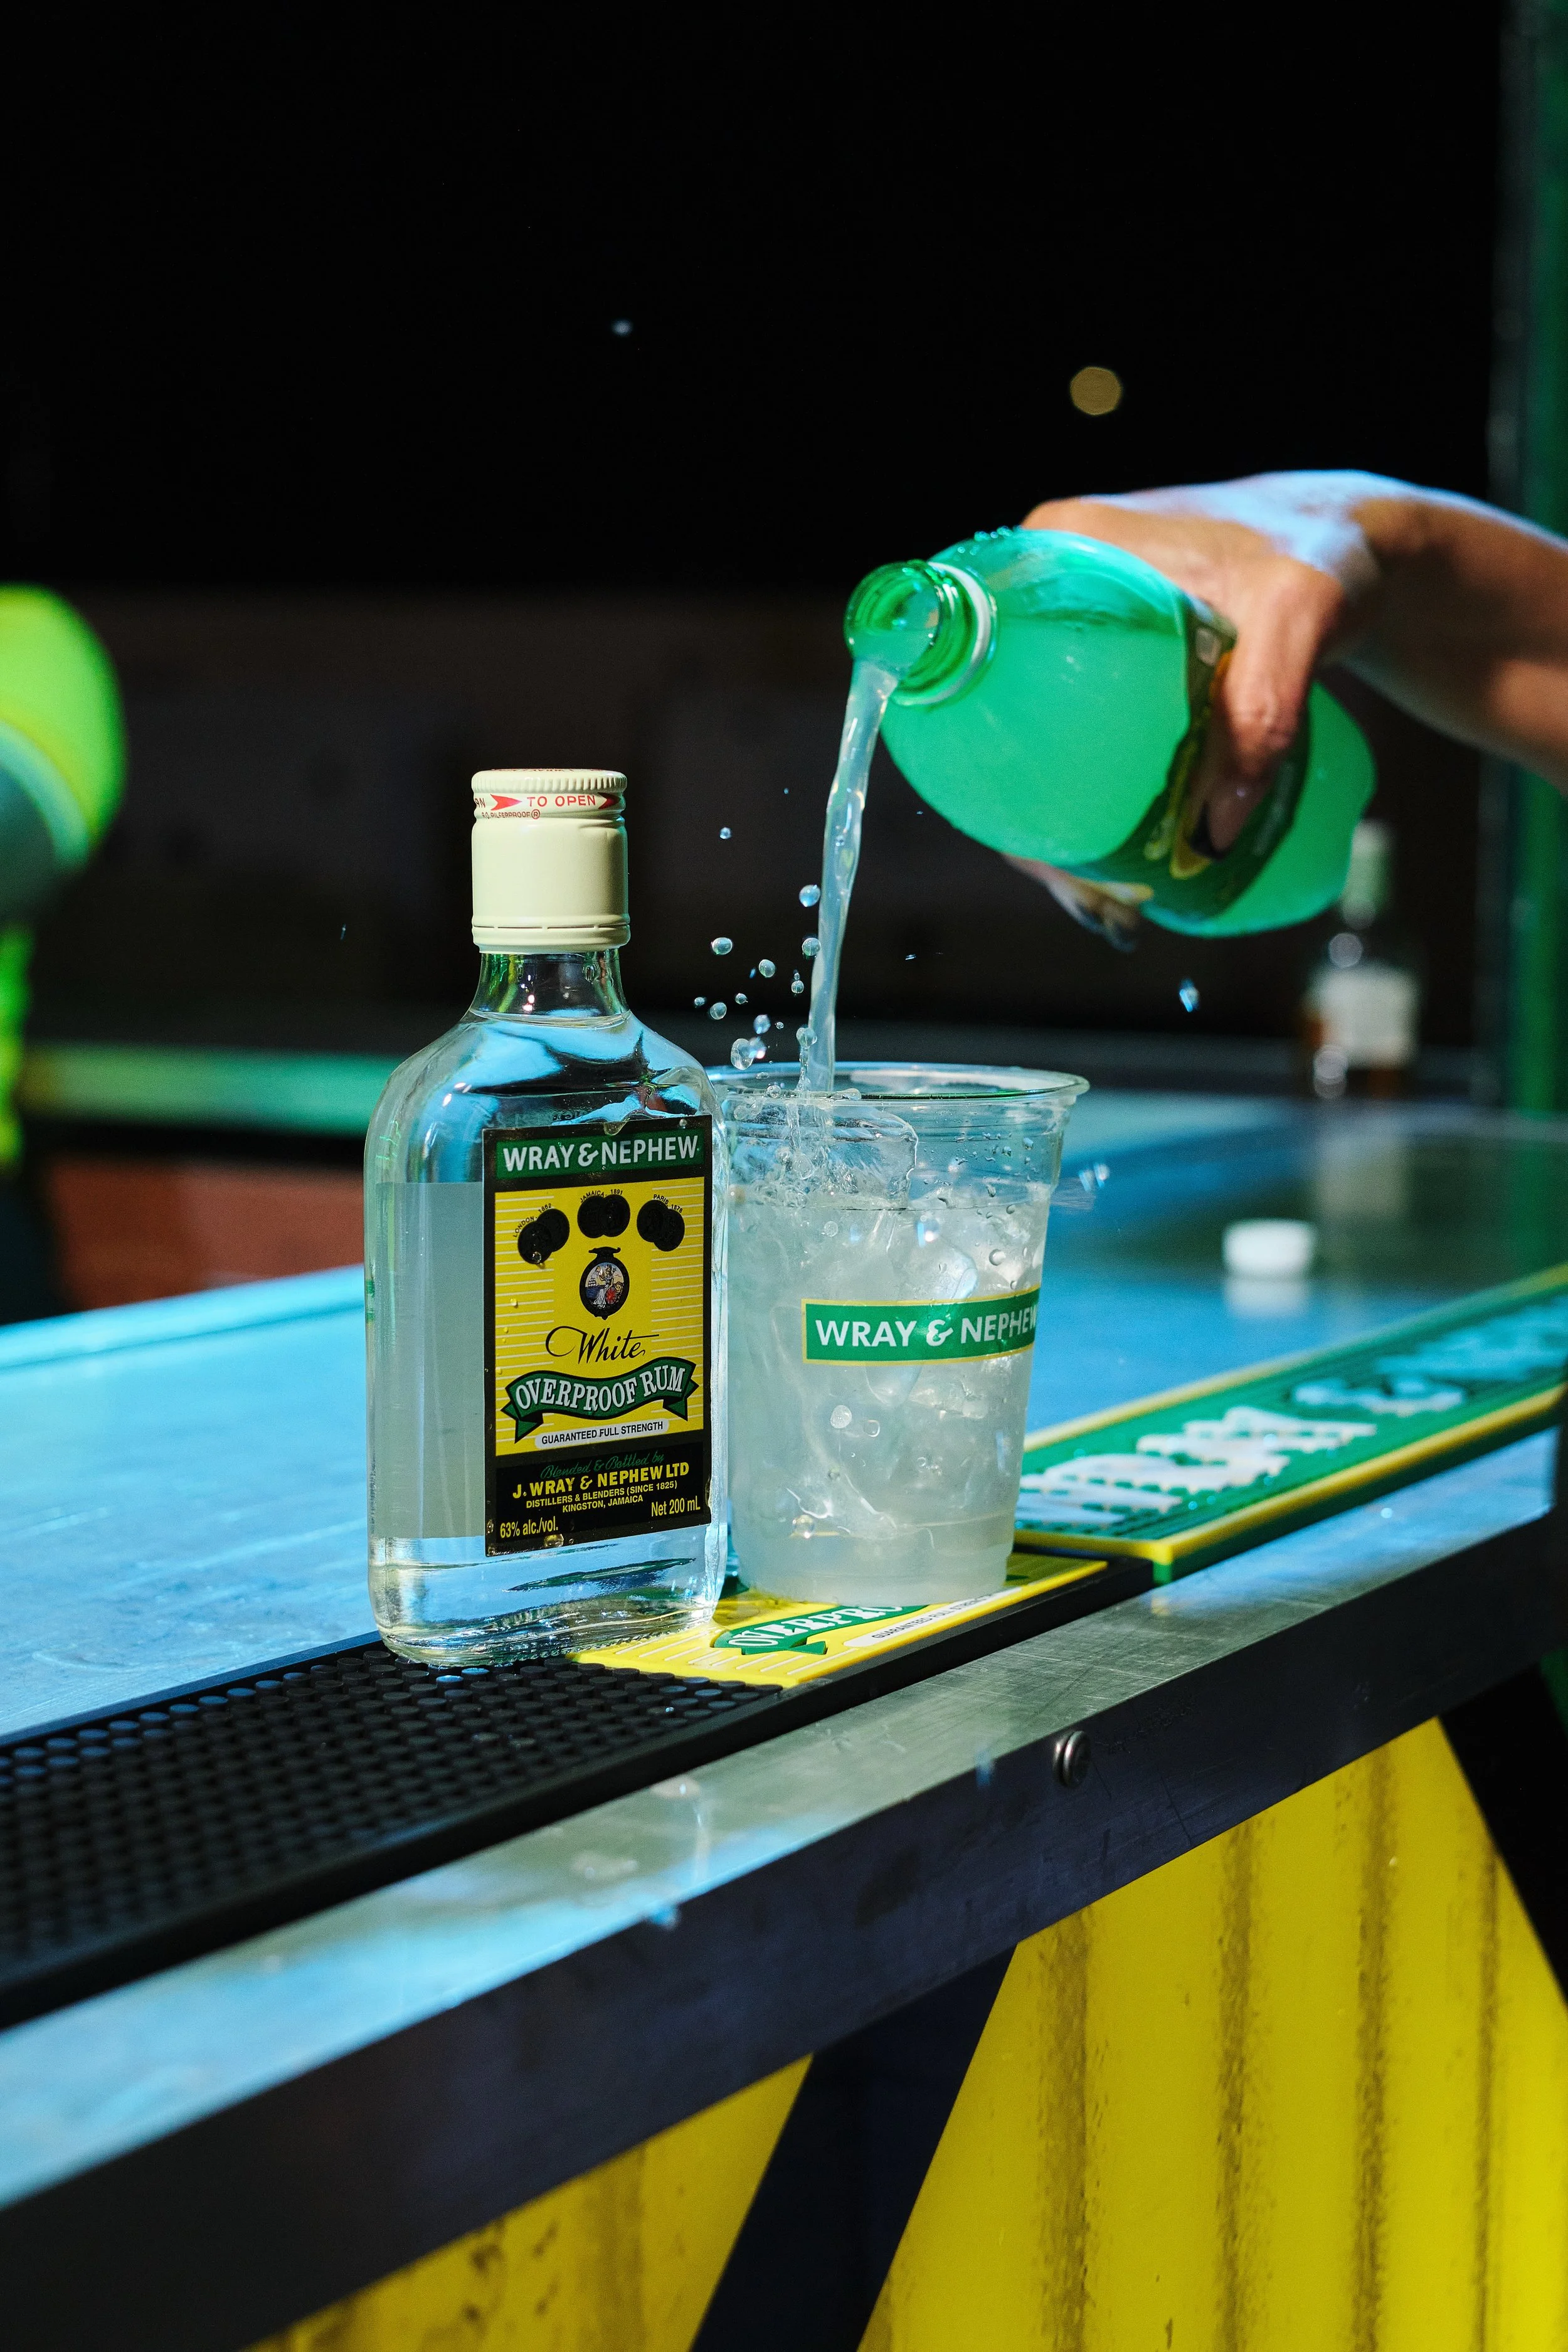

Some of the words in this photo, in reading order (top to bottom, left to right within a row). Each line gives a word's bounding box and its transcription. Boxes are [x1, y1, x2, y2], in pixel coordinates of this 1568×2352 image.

[527, 796, 548, 807] TO
[555, 795, 596, 807] OPEN
[538, 1203, 551, 1213] 1862
[671, 1204, 683, 1213] 1878
[815, 1320, 917, 1347] WRAY
[926, 1319, 953, 1347] &
[961, 1305, 1037, 1343] NEPHEW
[545, 1326, 659, 1365] White
[516, 1379, 637, 1411] OVERPROOF
[640, 1365, 686, 1397] RUM
[542, 1429, 597, 1444] GUARANTEED
[600, 1427, 618, 1437] FULL
[621, 1421, 663, 1434] STRENGTH
[540, 1460, 591, 1479] Blended
[593, 1459, 604, 1471] &
[605, 1453, 649, 1470] Bottled
[652, 1450, 665, 1463] by
[512, 1484, 527, 1499] J.
[530, 1477, 575, 1496] WRAY
[580, 1476, 593, 1490] &
[598, 1466, 663, 1488] NEPHEW
[665, 1462, 689, 1478] LTD
[526, 1494, 573, 1508] DISTILLERS
[583, 1489, 625, 1501] BLENDERS
[627, 1484, 654, 1496] (SINCE
[656, 1480, 677, 1491] 1825)
[563, 1500, 606, 1513] KINGSTON,
[608, 1495, 644, 1507] JAMAICA
[651, 1502, 667, 1517] Net
[669, 1498, 686, 1515] 200
[687, 1496, 701, 1512] mL
[500, 1521, 520, 1539] 63%
[522, 1516, 559, 1535] alc./vol.
[872, 1616, 932, 1638] GUARANTEED
[930, 1610, 953, 1621] FULL
